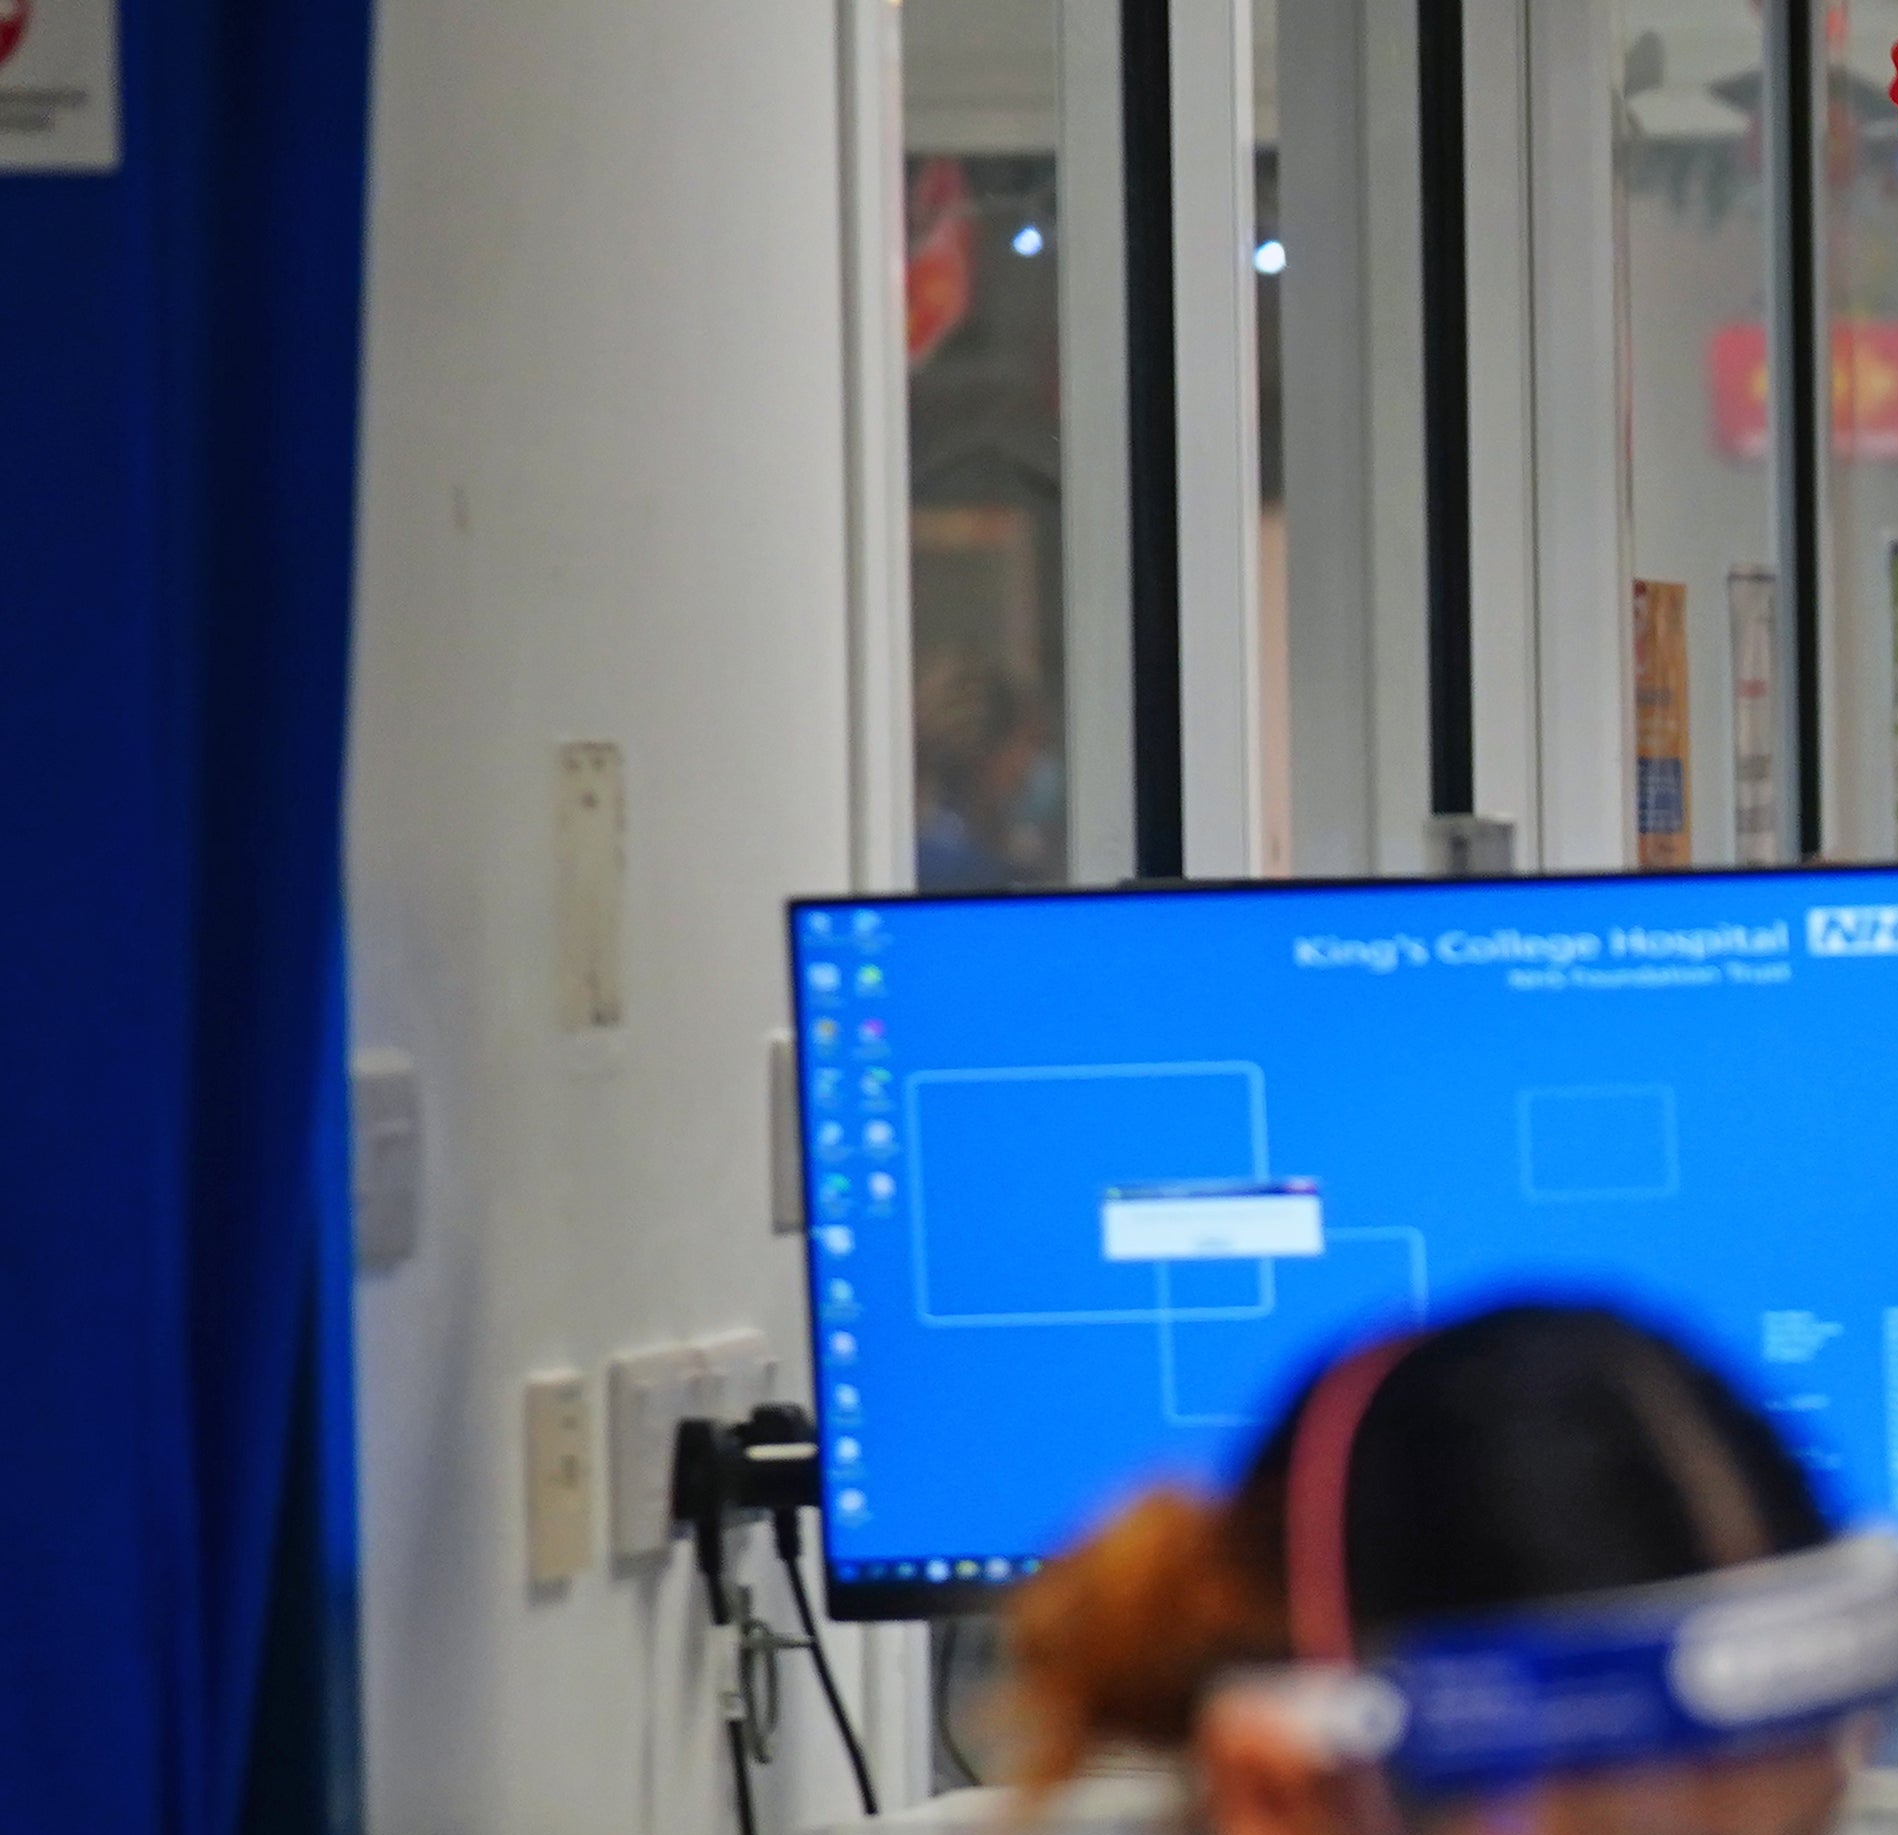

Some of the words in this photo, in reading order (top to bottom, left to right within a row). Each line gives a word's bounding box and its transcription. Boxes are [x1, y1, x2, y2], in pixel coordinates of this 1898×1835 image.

[1295, 932, 1430, 975] King's
[1434, 928, 1601, 966] College
[1607, 919, 1790, 961] Hospital
